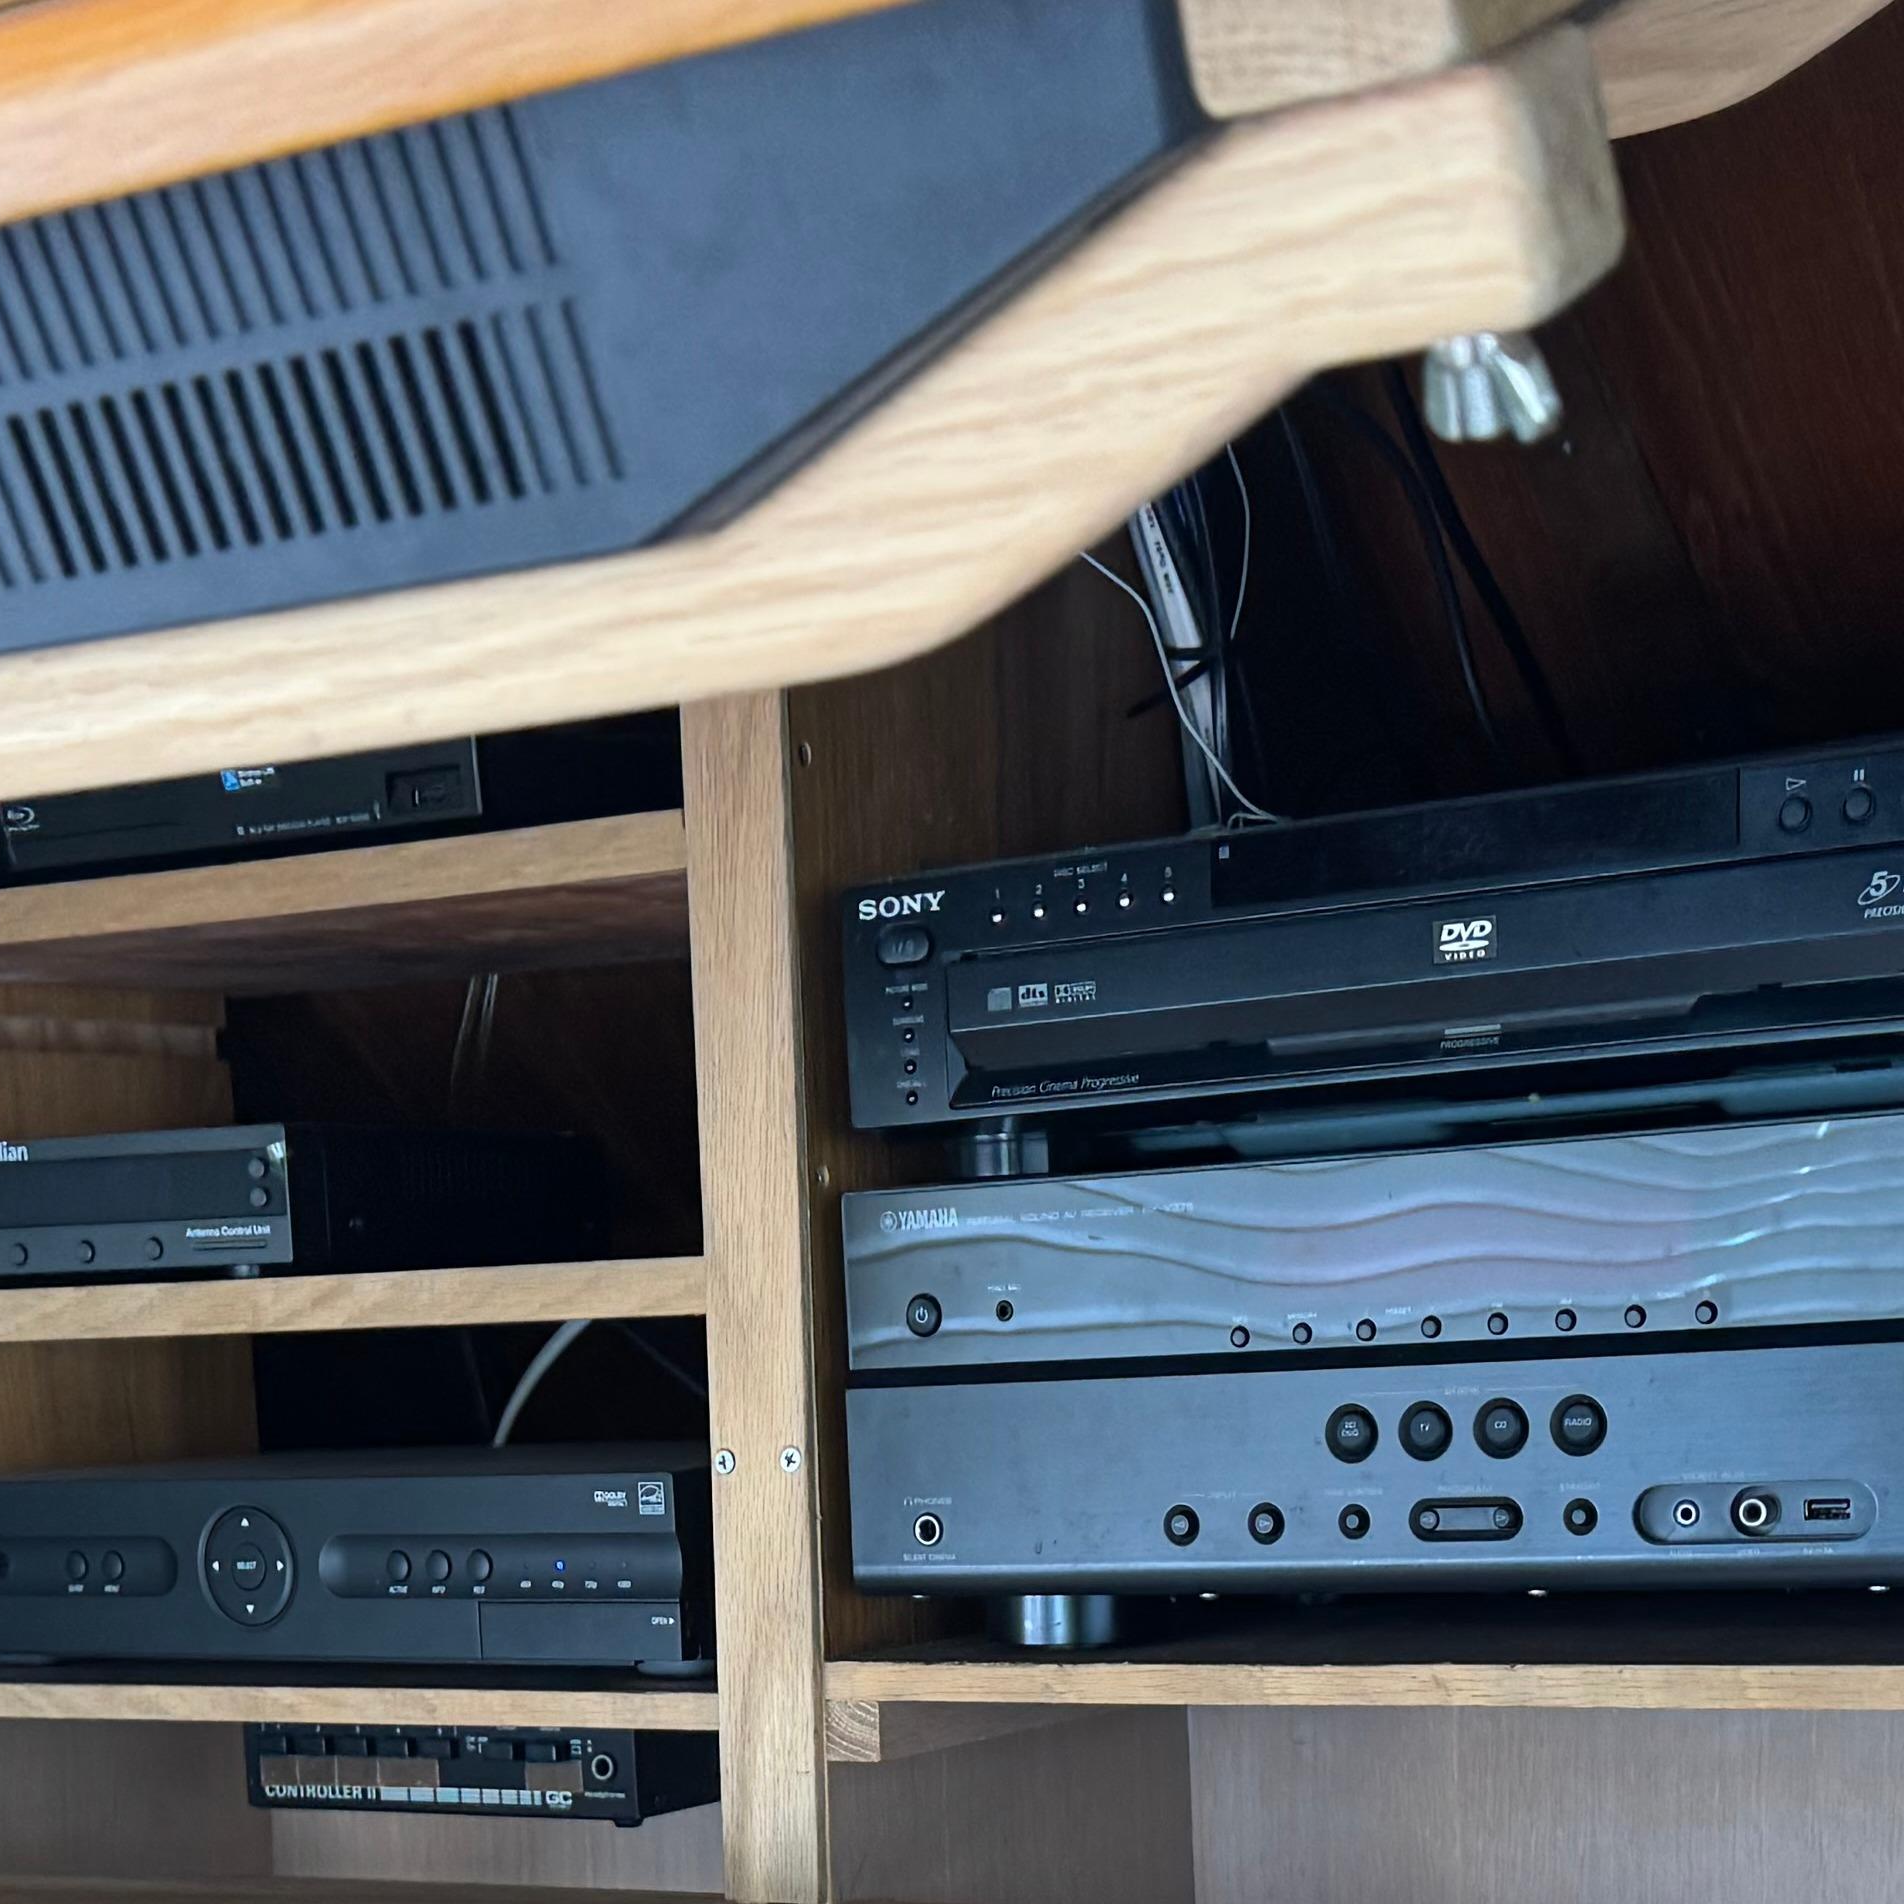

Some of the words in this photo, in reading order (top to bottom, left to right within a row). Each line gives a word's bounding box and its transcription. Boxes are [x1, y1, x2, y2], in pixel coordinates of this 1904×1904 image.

[1036, 884, 1043, 895] 2
[1078, 878, 1085, 889] 3
[858, 889, 946, 921] SONY
[1440, 919, 1493, 942] DVD
[1444, 949, 1486, 961] VIDEO
[1039, 1080, 1078, 1093] Cinema
[1081, 1073, 1140, 1090] Progressive
[897, 1207, 959, 1230] YAMAHA
[221, 1225, 252, 1236] Control
[253, 1224, 271, 1235] Unit
[1564, 1417, 1592, 1427] RADIO
[264, 1784, 362, 1799] CONTROLLER
[545, 1790, 573, 1804] GC
